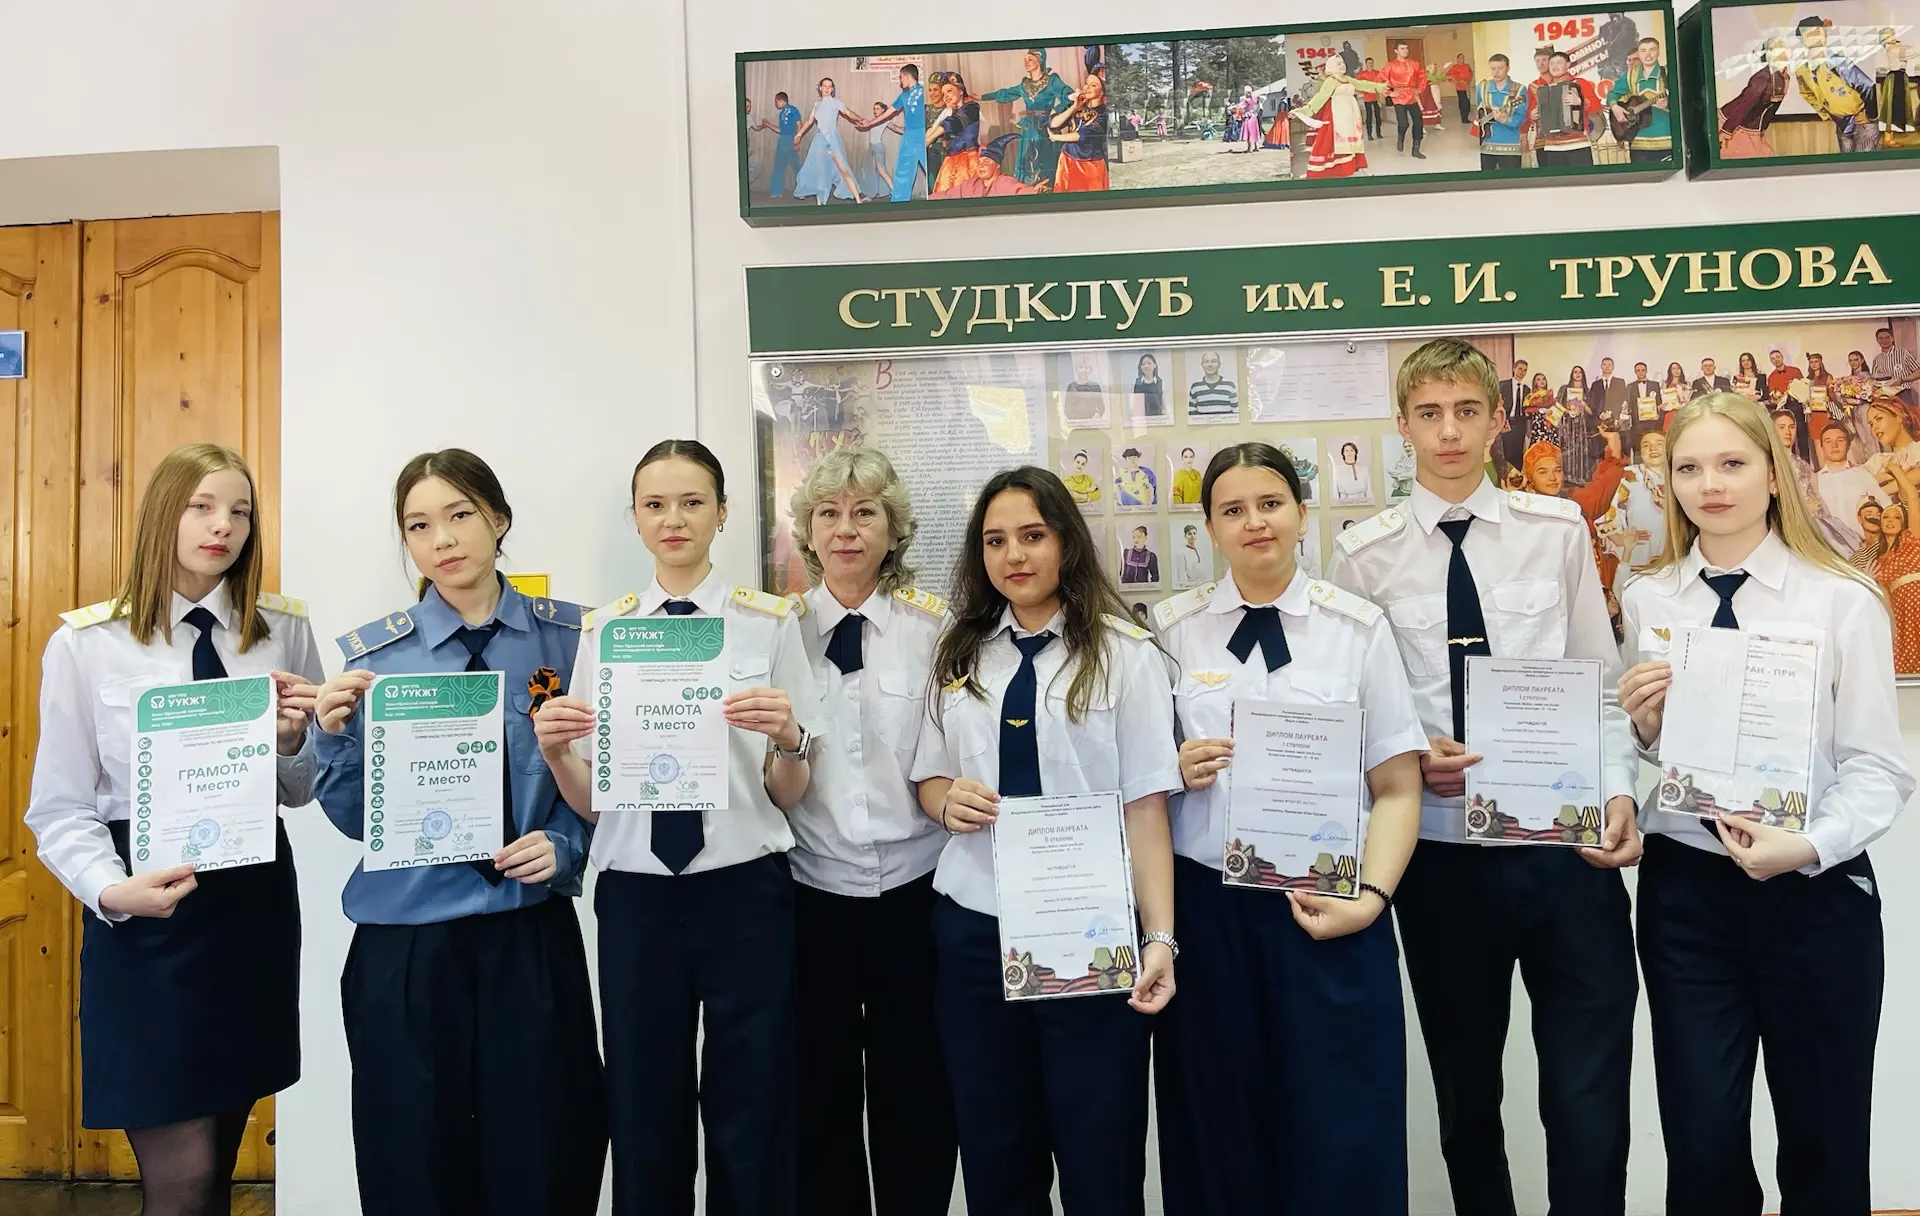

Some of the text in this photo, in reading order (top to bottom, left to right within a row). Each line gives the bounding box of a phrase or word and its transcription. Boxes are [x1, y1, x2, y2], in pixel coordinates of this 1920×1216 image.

[1534, 18, 1595, 41] 1945
[1297, 48, 1336, 59] 1945
[1569, 38, 1608, 62] ОМНЮ!
[1568, 49, 1609, 76] ОРЖУСЬ!
[838, 244, 1893, 338] СТУДКЛУБ им. Е. И. ТРУНОВА
[629, 631, 665, 640] УУКЖТ
[1774, 669, 1796, 678] ПРИ
[401, 688, 439, 698] УУКЖТ
[1502, 685, 1565, 694] ДИПЛОМ ЛАУРЕАТА
[168, 696, 207, 708] УУКЖТ
[636, 704, 702, 716] ГРАМОТА
[642, 720, 696, 731] 3 место
[1266, 731, 1328, 742] ДИПЛОМ ЛАУРЕАТА
[410, 758, 478, 773] ГРАМОТА
[178, 763, 249, 781] ГРАМОТА
[417, 775, 471, 786] 2 место
[187, 780, 241, 794] 1 место
[1028, 825, 1089, 836] ДИПЛОМ ЛАУРЕАТА
